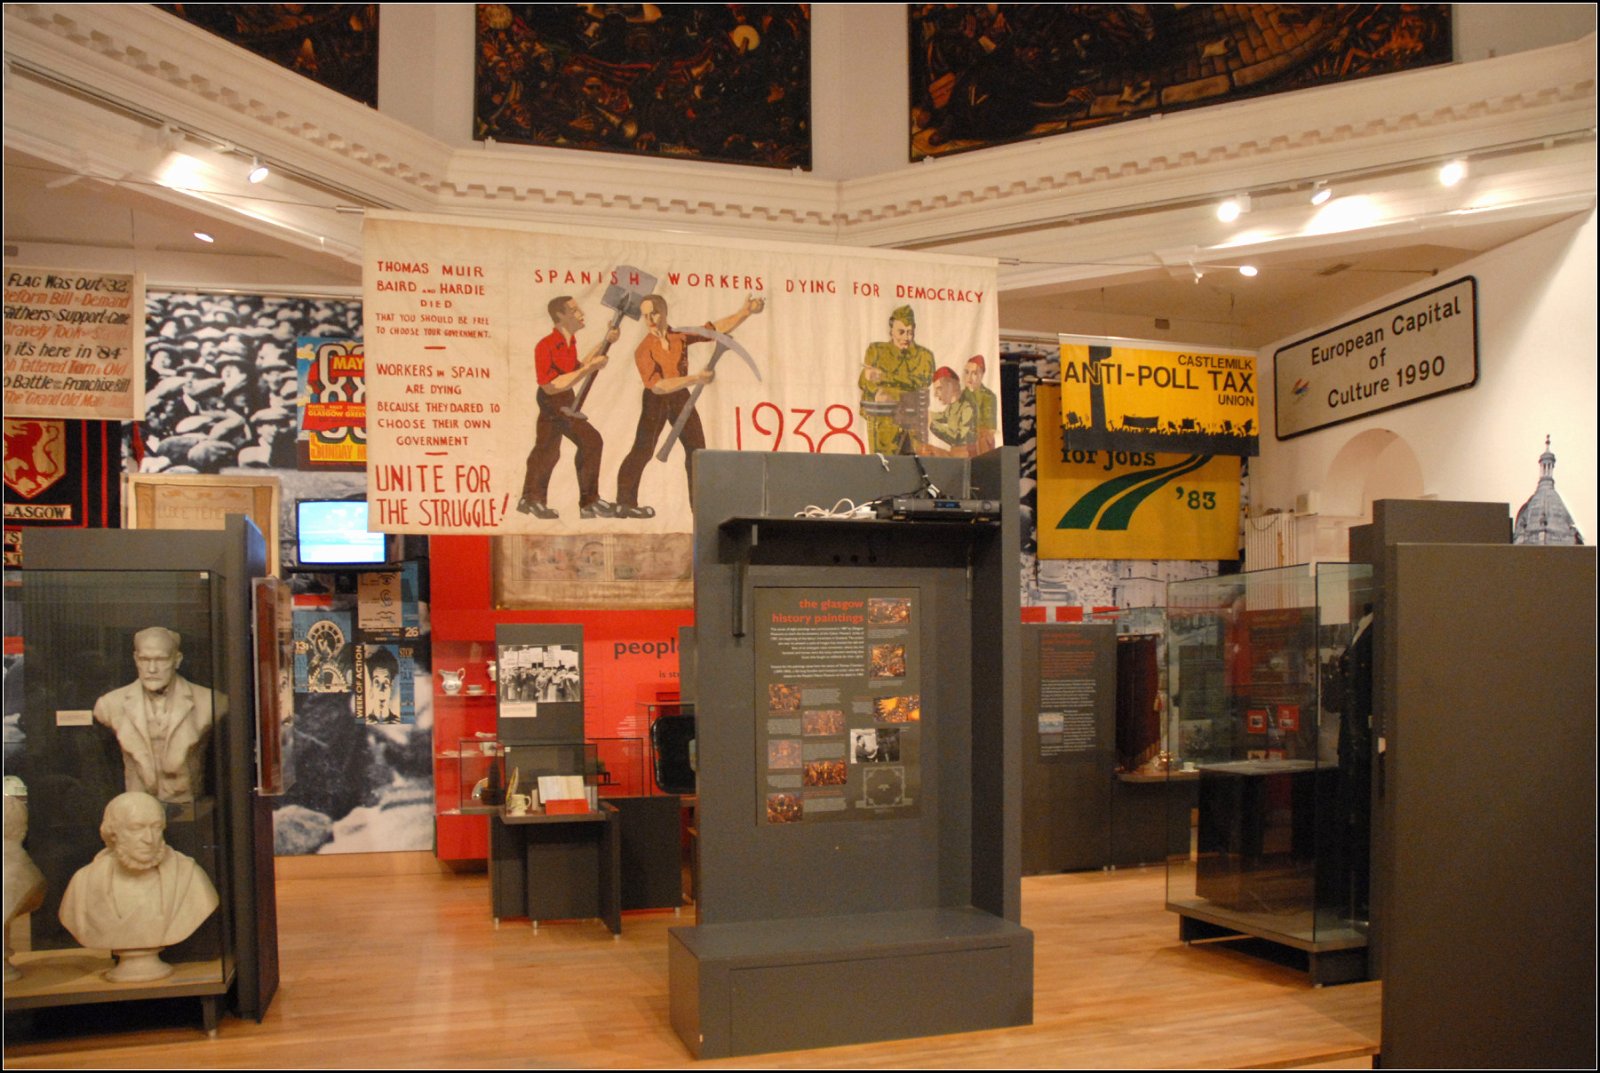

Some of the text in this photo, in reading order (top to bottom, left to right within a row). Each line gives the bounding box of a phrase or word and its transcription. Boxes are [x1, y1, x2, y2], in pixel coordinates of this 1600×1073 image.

[377, 261, 484, 277] THOMAS MUIR
[377, 280, 417, 293] BAIRD
[440, 284, 485, 296] HARDIE
[534, 269, 983, 303] SPANISH WORKERS DYING FOR DEMOCRACY
[420, 299, 453, 309] DIED
[376, 312, 395, 321] THAT
[400, 313, 416, 322] YOU
[420, 314, 453, 324] SHOULD
[376, 326, 385, 334] TO
[390, 328, 420, 336] CHOOSE
[424, 328, 441, 336] YOUR
[1311, 296, 1461, 366] European Capital
[39, 343, 72, 359] here
[75, 345, 92, 358] in
[1369, 348, 1386, 370] of
[333, 357, 364, 371] MAY
[376, 363, 433, 377] WORKERS
[451, 366, 490, 378] SPAIN
[1178, 354, 1253, 371] CASTLEMILK
[1064, 361, 1254, 393] ANTI-POLL TAX
[1327, 355, 1445, 408] Culture 1990
[405, 384, 462, 394] ARE DYING
[377, 401, 419, 412] BECAUSE
[426, 402, 448, 412] THEY
[450, 403, 483, 413] DARED
[490, 403, 500, 413] TO
[1217, 395, 1255, 407] UNION
[308, 410, 344, 418] GLASGOW
[378, 418, 491, 429] CHOOSE THEIR OWN
[735, 401, 866, 455] 1938
[396, 436, 469, 446] GOVERNMENT
[376, 464, 491, 493] UNITE FOR
[1175, 486, 1216, 510] '83
[376, 492, 509, 528] THE STRUGGLE!
[800, 599, 864, 611] the glasgow
[772, 612, 864, 625] history paintings
[613, 637, 679, 660] peopl
